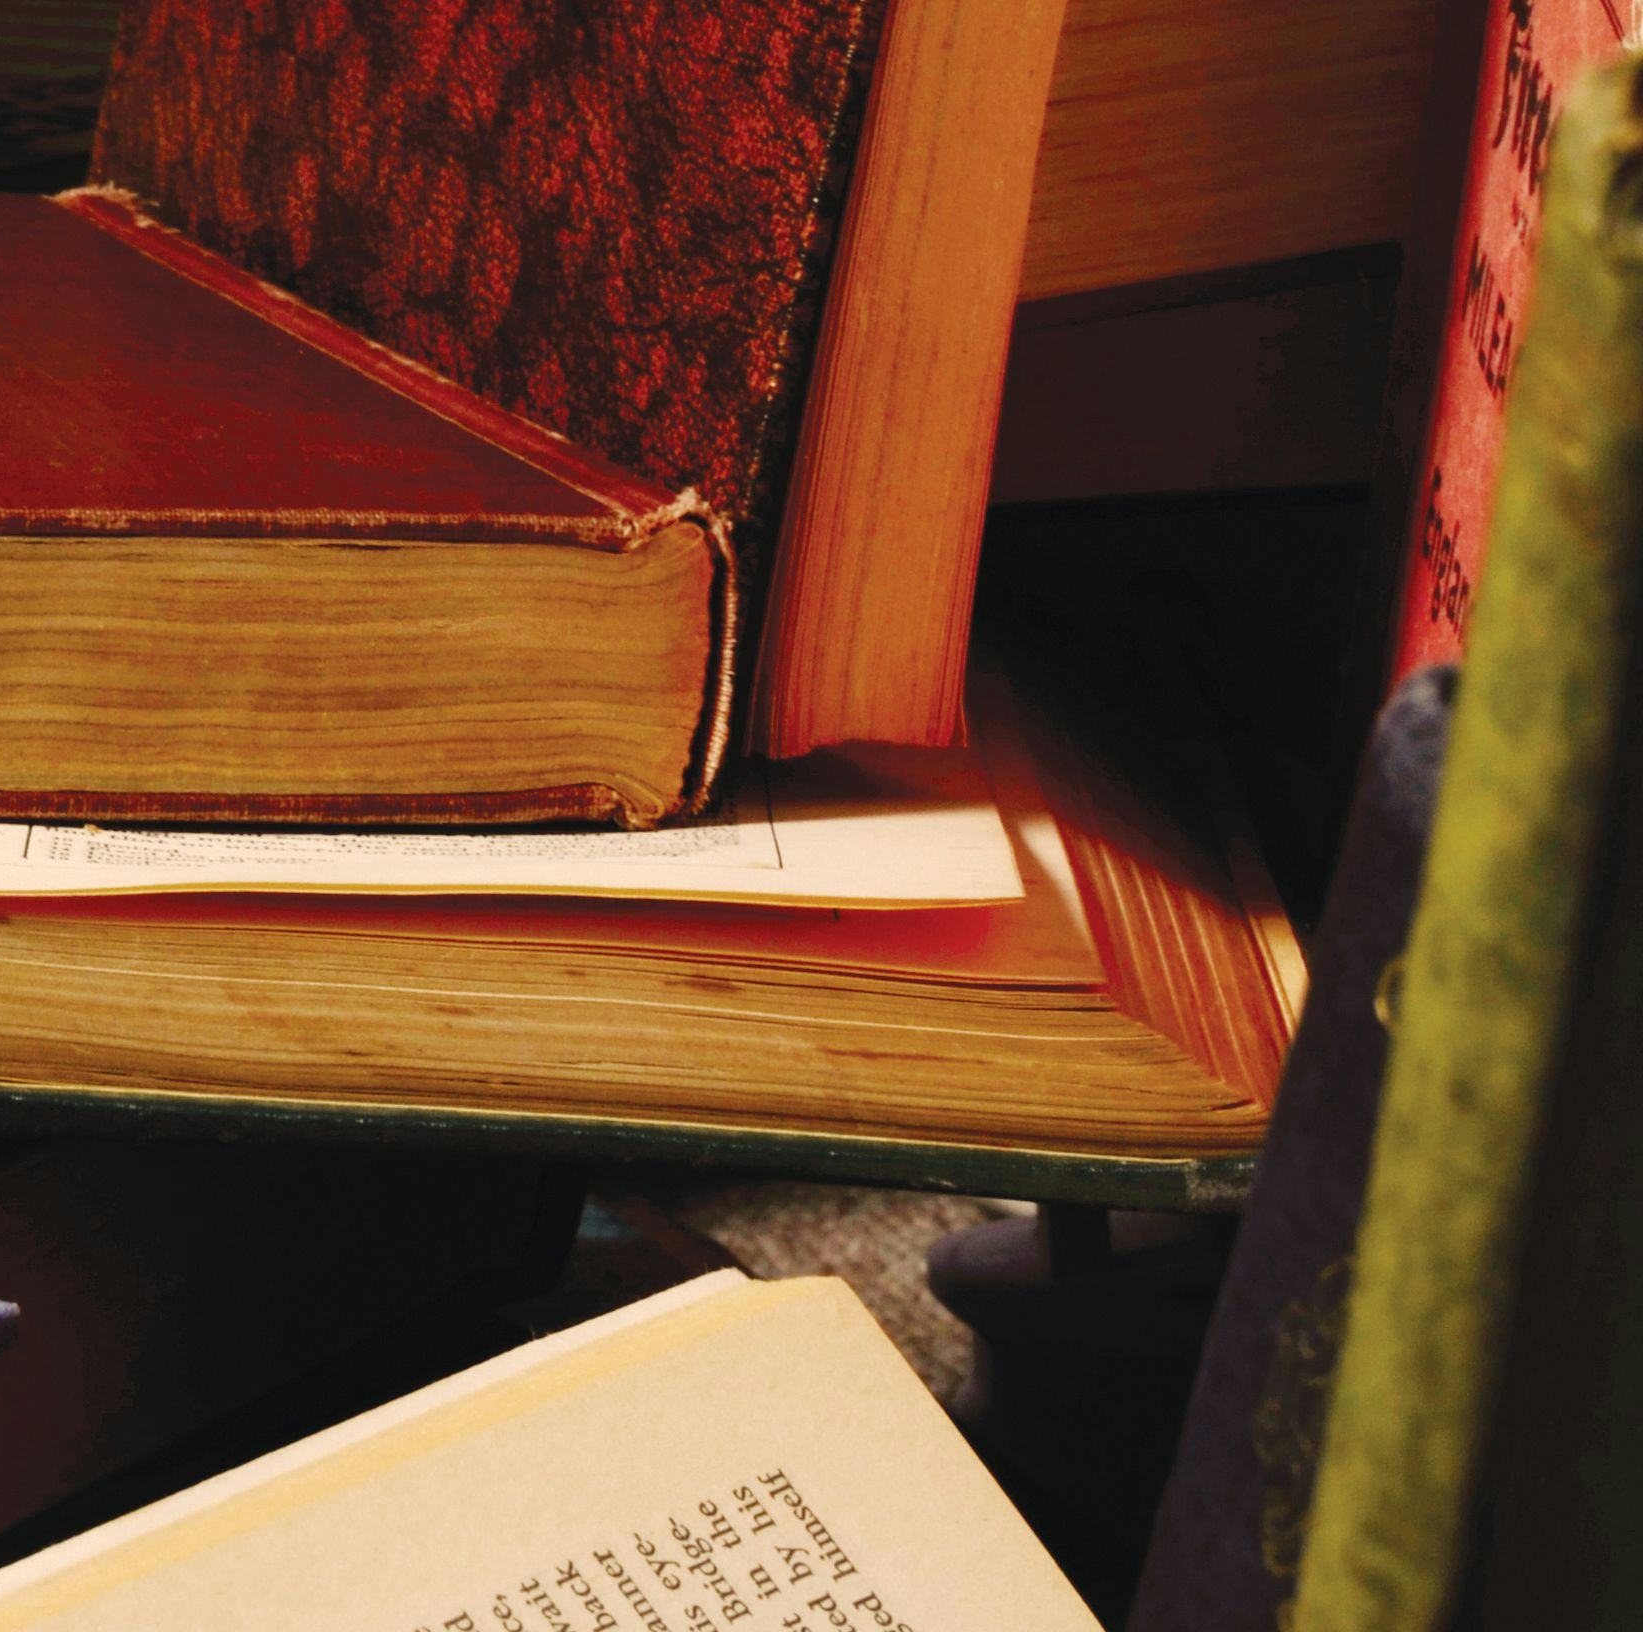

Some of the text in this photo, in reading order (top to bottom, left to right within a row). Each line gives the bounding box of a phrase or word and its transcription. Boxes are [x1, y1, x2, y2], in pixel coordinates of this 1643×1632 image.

[1420, 464, 1475, 640] Englan
[698, 1498, 742, 1550] the
[731, 1484, 778, 1535] his
[756, 1467, 859, 1582] himself
[592, 1547, 672, 1632] anner
[631, 1531, 682, 1591] eye-
[667, 1516, 752, 1623] Bridge-
[747, 1562, 782, 1601] in
[774, 1543, 815, 1587] by
[555, 1559, 620, 1632] back
